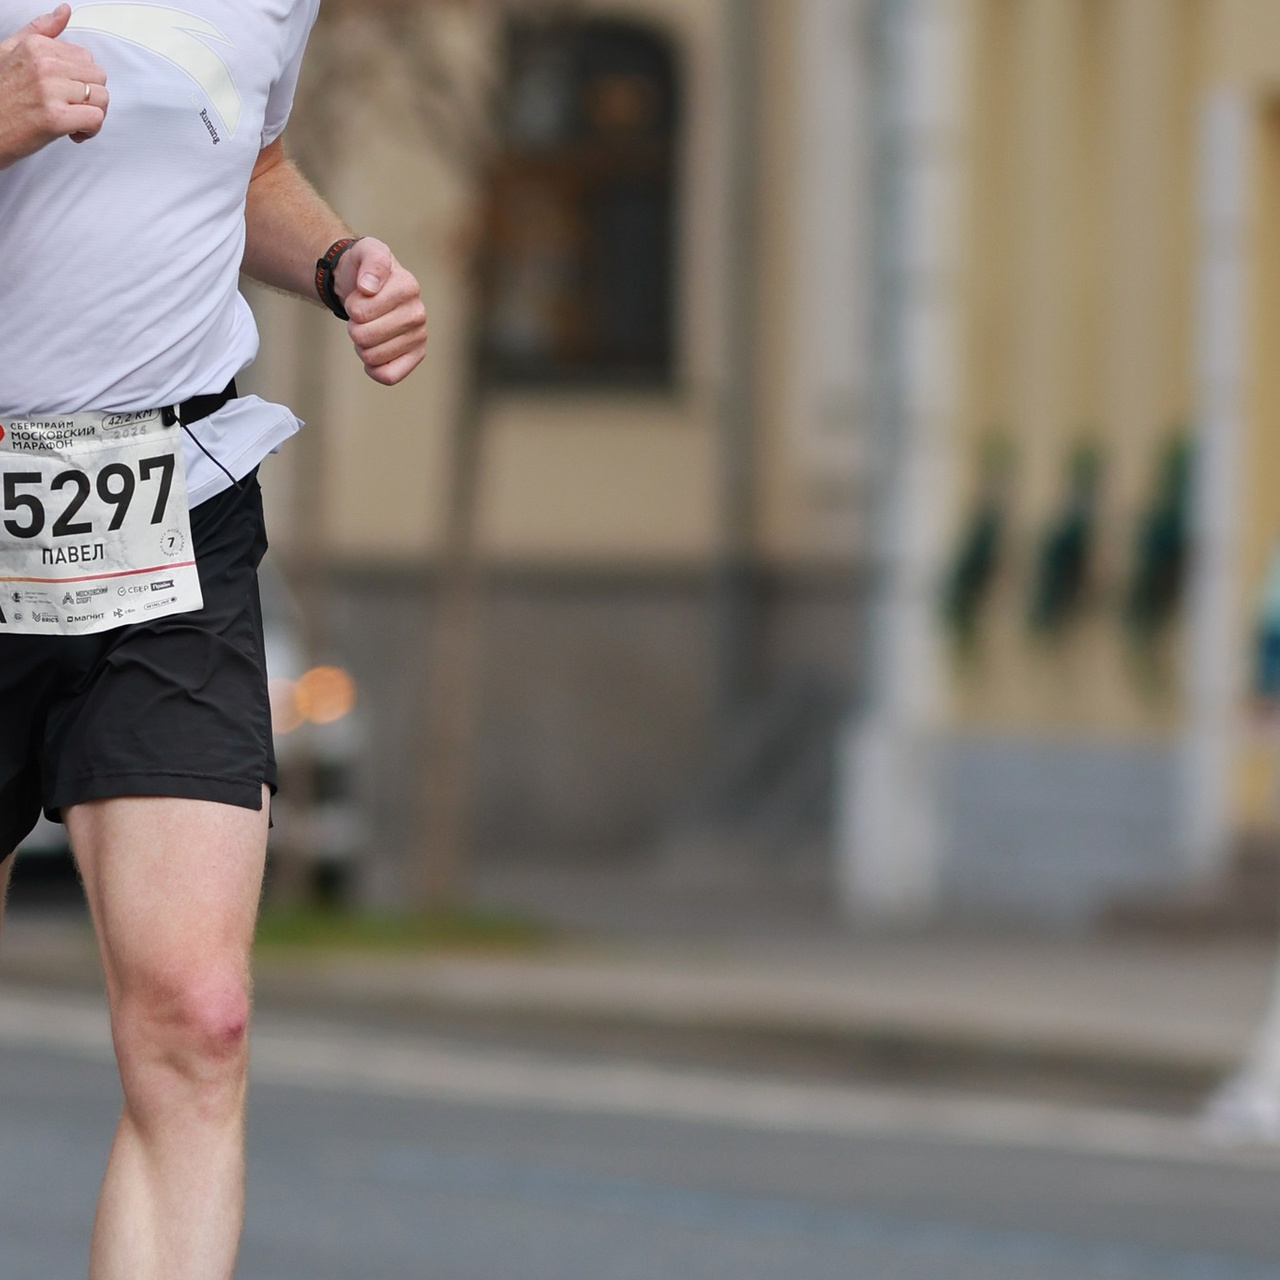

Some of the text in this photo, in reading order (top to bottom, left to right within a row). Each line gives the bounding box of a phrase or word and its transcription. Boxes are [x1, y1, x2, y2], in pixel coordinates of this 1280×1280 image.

[199, 108, 220, 145] Running
[10, 421, 74, 430] СБЕРПРАЙМ
[108, 413, 132, 426] 42,2
[11, 426, 96, 441] МОСКОВСКИЙ
[12, 439, 74, 451] МАРАФОН
[167, 536, 175, 548] 7
[42, 543, 104, 565] ПАВЕЛ
[128, 585, 149, 594] СБЕР
